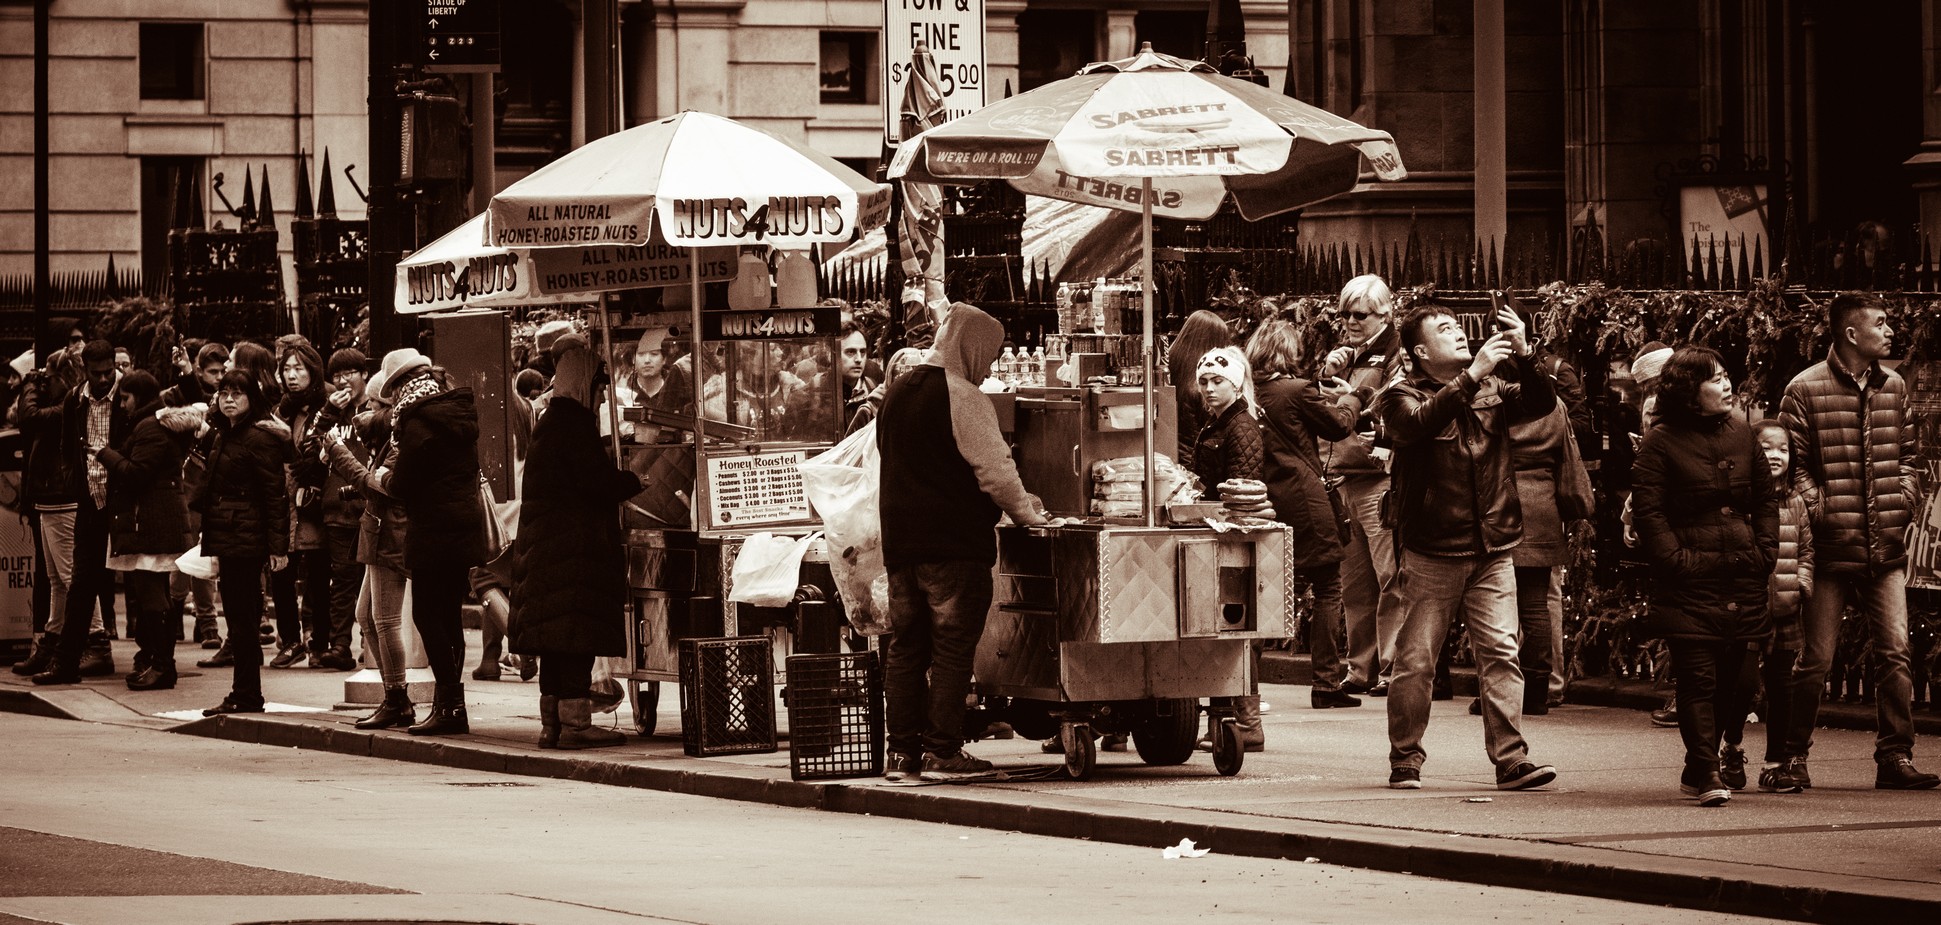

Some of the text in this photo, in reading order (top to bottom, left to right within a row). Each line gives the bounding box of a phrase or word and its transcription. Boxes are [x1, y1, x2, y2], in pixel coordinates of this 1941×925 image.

[428, 7, 457, 15] LIBERTY
[911, 22, 960, 50] FINE
[1090, 102, 1227, 130] SABRETT
[936, 151, 1037, 164] WE'RE ON A ROLL !!!
[1103, 144, 1240, 168] SABRETT
[527, 203, 611, 222] ALL NATURAL
[673, 195, 844, 241] NUTS4NUTS
[499, 224, 638, 244] HONEY-ROASTED NUTS
[1689, 221, 1711, 232] The
[582, 244, 689, 266] ALL NATURAL
[407, 252, 519, 305] NUTS4NUTS
[546, 264, 680, 290] HONEY-ROASTED
[721, 312, 816, 337] NUTS4NUTS
[720, 454, 796, 472] Honey Roasted
[11, 556, 33, 571] LIFT
